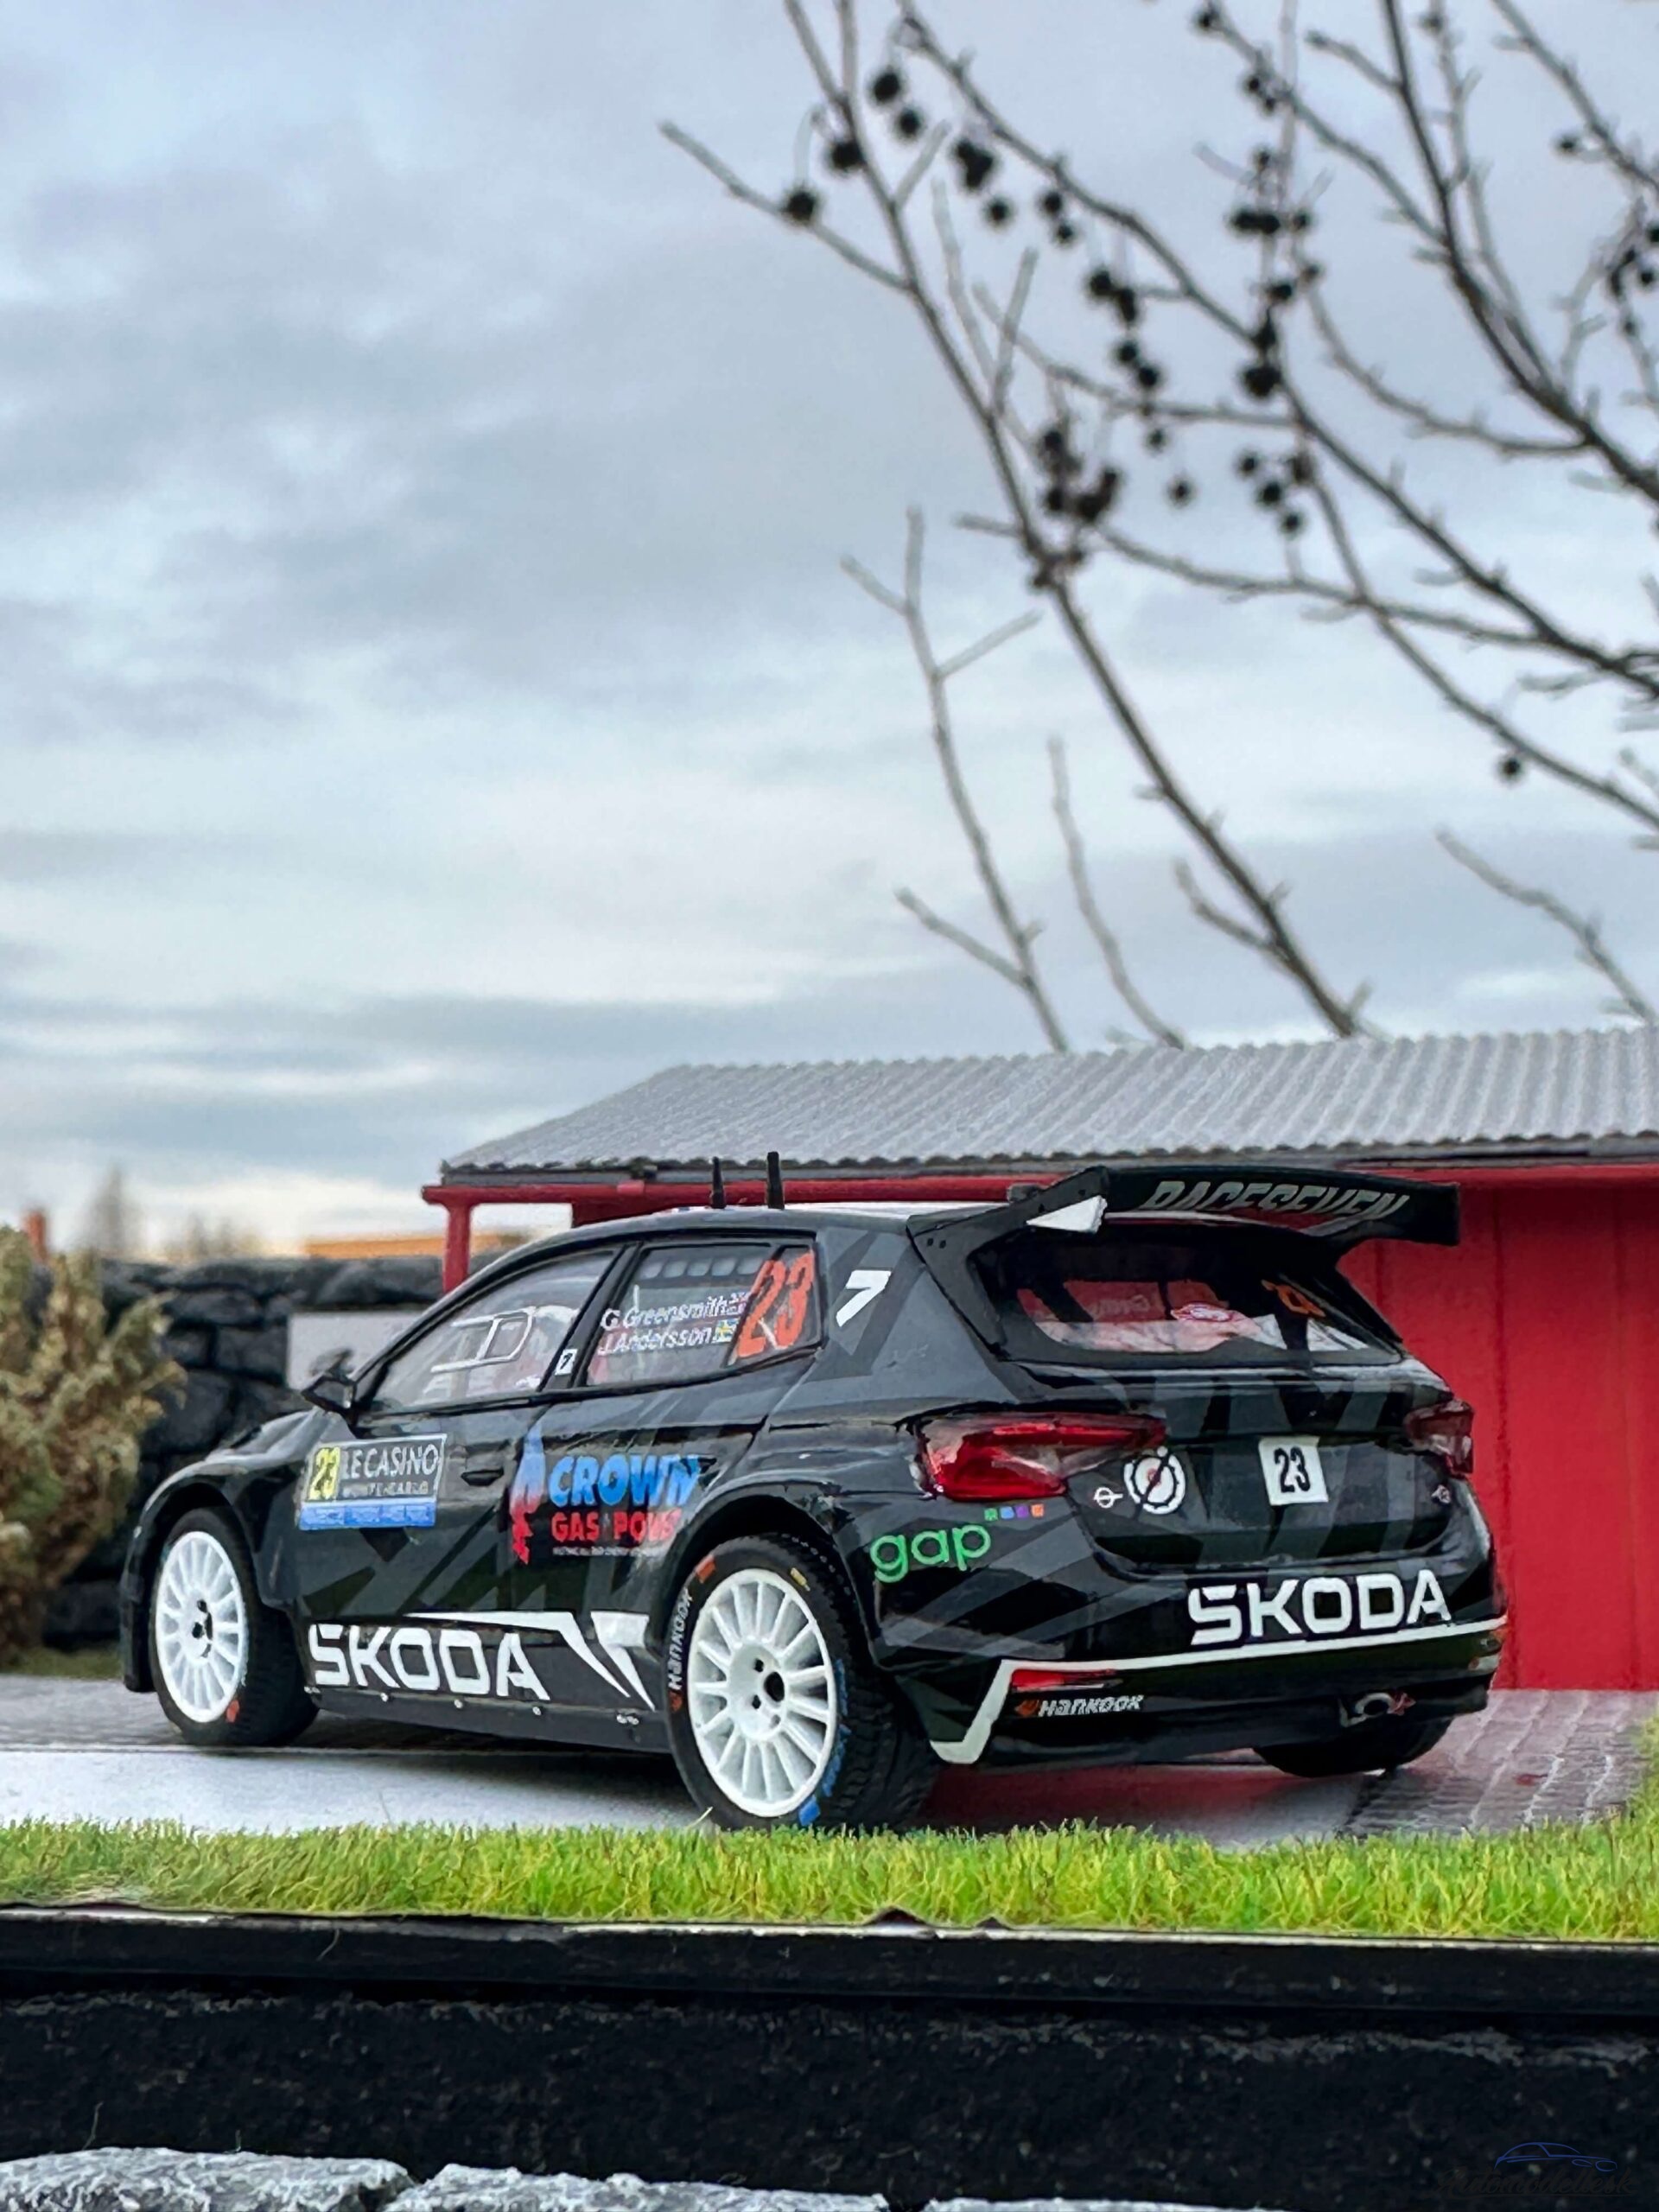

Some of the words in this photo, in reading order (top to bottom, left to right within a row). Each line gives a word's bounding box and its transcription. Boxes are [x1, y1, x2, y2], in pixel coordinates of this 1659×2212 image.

[737, 1249, 815, 1357] 23
[836, 1269, 892, 1328] 7
[549, 1453, 702, 1508] CROWN
[1274, 1446, 1312, 1494] 23
[551, 1511, 600, 1543] GAS
[869, 1524, 992, 1584] gap
